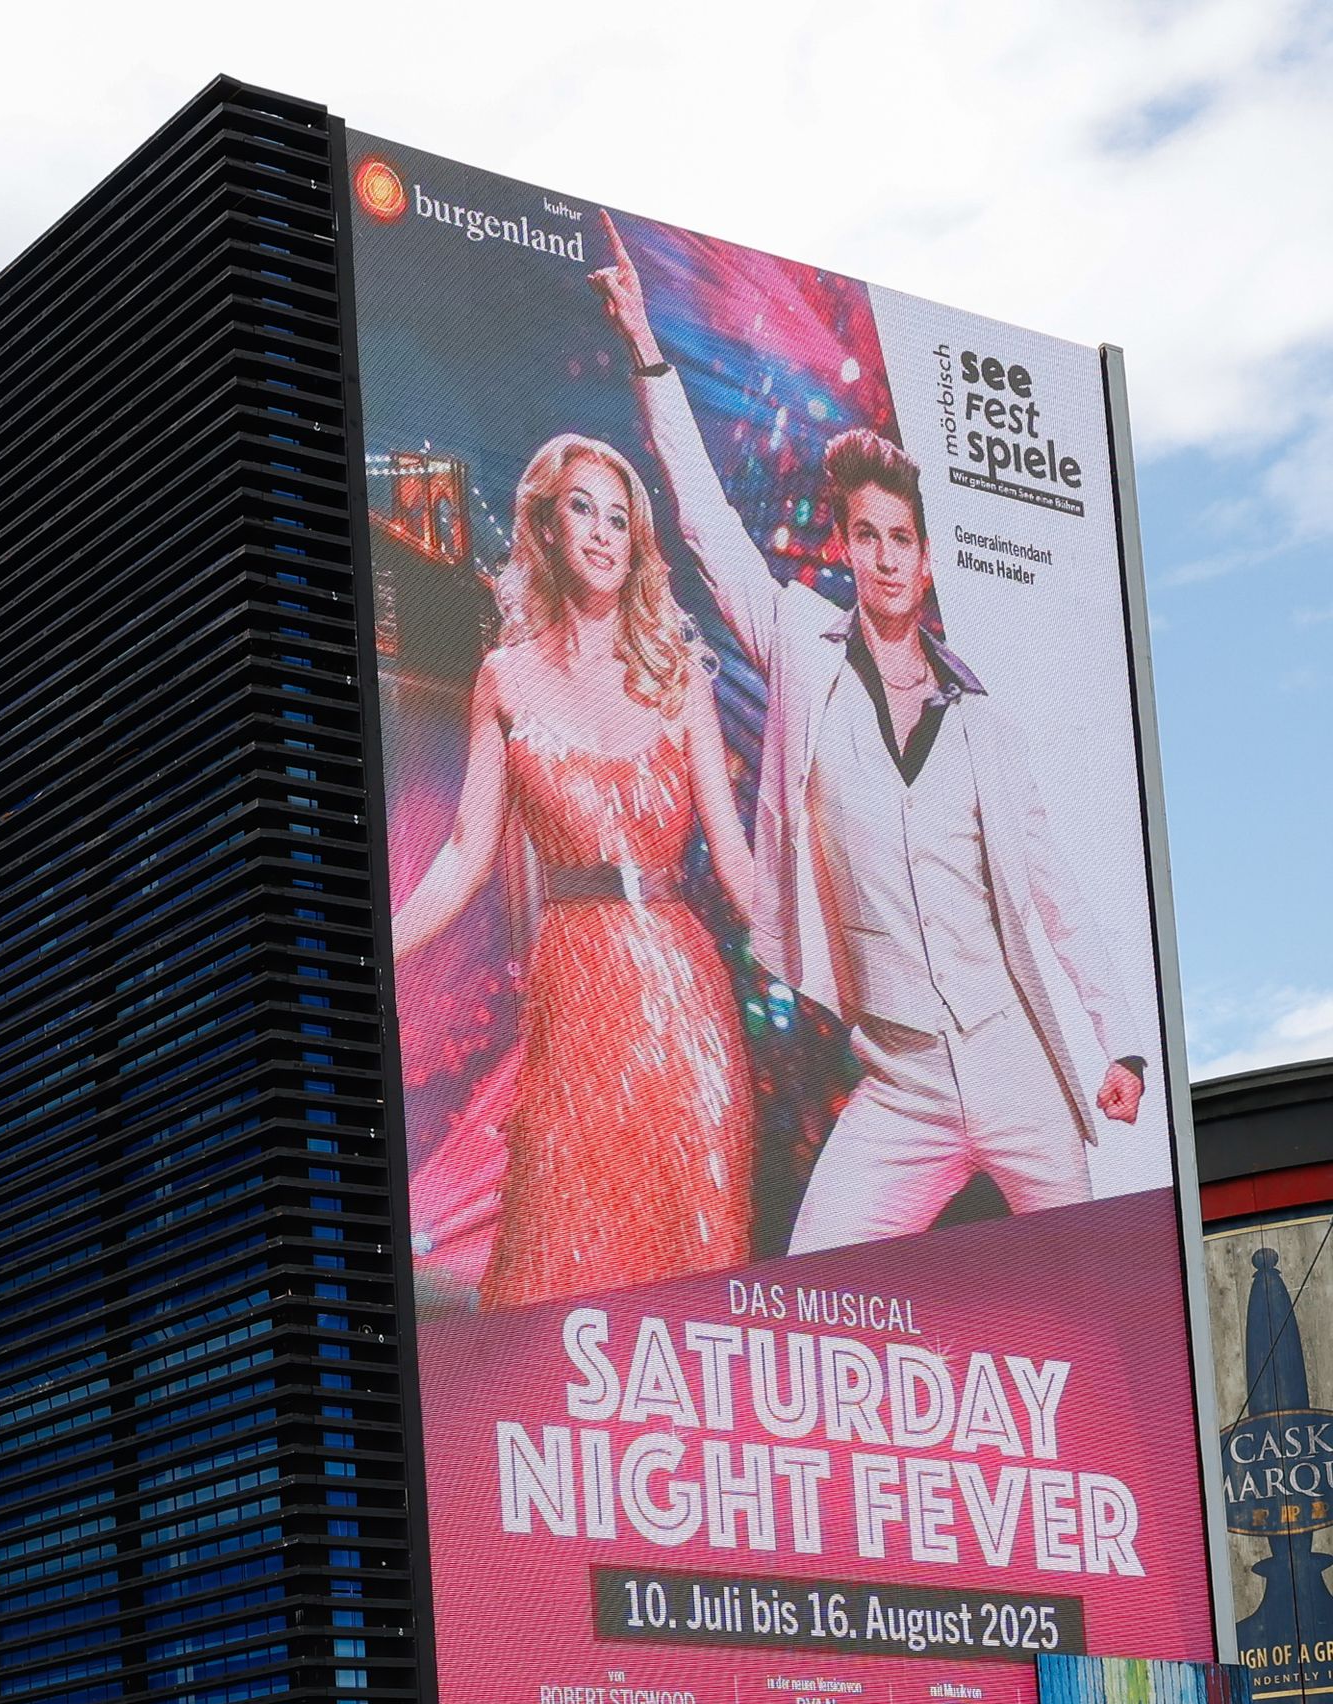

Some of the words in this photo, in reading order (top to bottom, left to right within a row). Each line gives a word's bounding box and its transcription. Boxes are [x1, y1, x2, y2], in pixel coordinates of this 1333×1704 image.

[414, 184, 585, 263] burgenland
[543, 197, 583, 220] kultur
[960, 350, 1032, 398] see
[933, 343, 958, 457] mörbisch
[967, 430, 1082, 489] spiele
[952, 470, 969, 484] Wir
[969, 477, 997, 494] geben
[998, 483, 1017, 497] dem
[1018, 488, 1035, 502] See
[1035, 493, 1054, 507] eine
[1055, 497, 1081, 513] Bühne
[955, 524, 1053, 566] Generalintendant
[956, 549, 994, 577] Alfons
[996, 559, 1035, 585] Haider
[728, 1279, 786, 1322] DAS
[797, 1287, 922, 1336] MUSICAL
[561, 1307, 1072, 1462] SATURDAY
[1230, 1422, 1333, 1464] CASK
[495, 1420, 831, 1556] NIGHT
[852, 1453, 1148, 1578] FEVER
[624, 1580, 677, 1629] 10.
[686, 1584, 743, 1633] Juli
[751, 1587, 800, 1636] bis
[808, 1592, 857, 1640] 16.
[865, 1596, 975, 1653] August
[980, 1602, 1059, 1651] 2025
[607, 1671, 625, 1683] von
[1240, 1647, 1268, 1669] IGN
[1272, 1644, 1292, 1666] OF
[1298, 1643, 1311, 1664] A
[775, 1676, 790, 1690] der
[791, 1679, 816, 1692] neuen
[817, 1678, 845, 1693] Version
[845, 1682, 862, 1694] von
[930, 1684, 944, 1697] mit
[944, 1683, 966, 1698] Musik
[967, 1687, 982, 1699] von
[1254, 1671, 1319, 1686] NDENTLY
